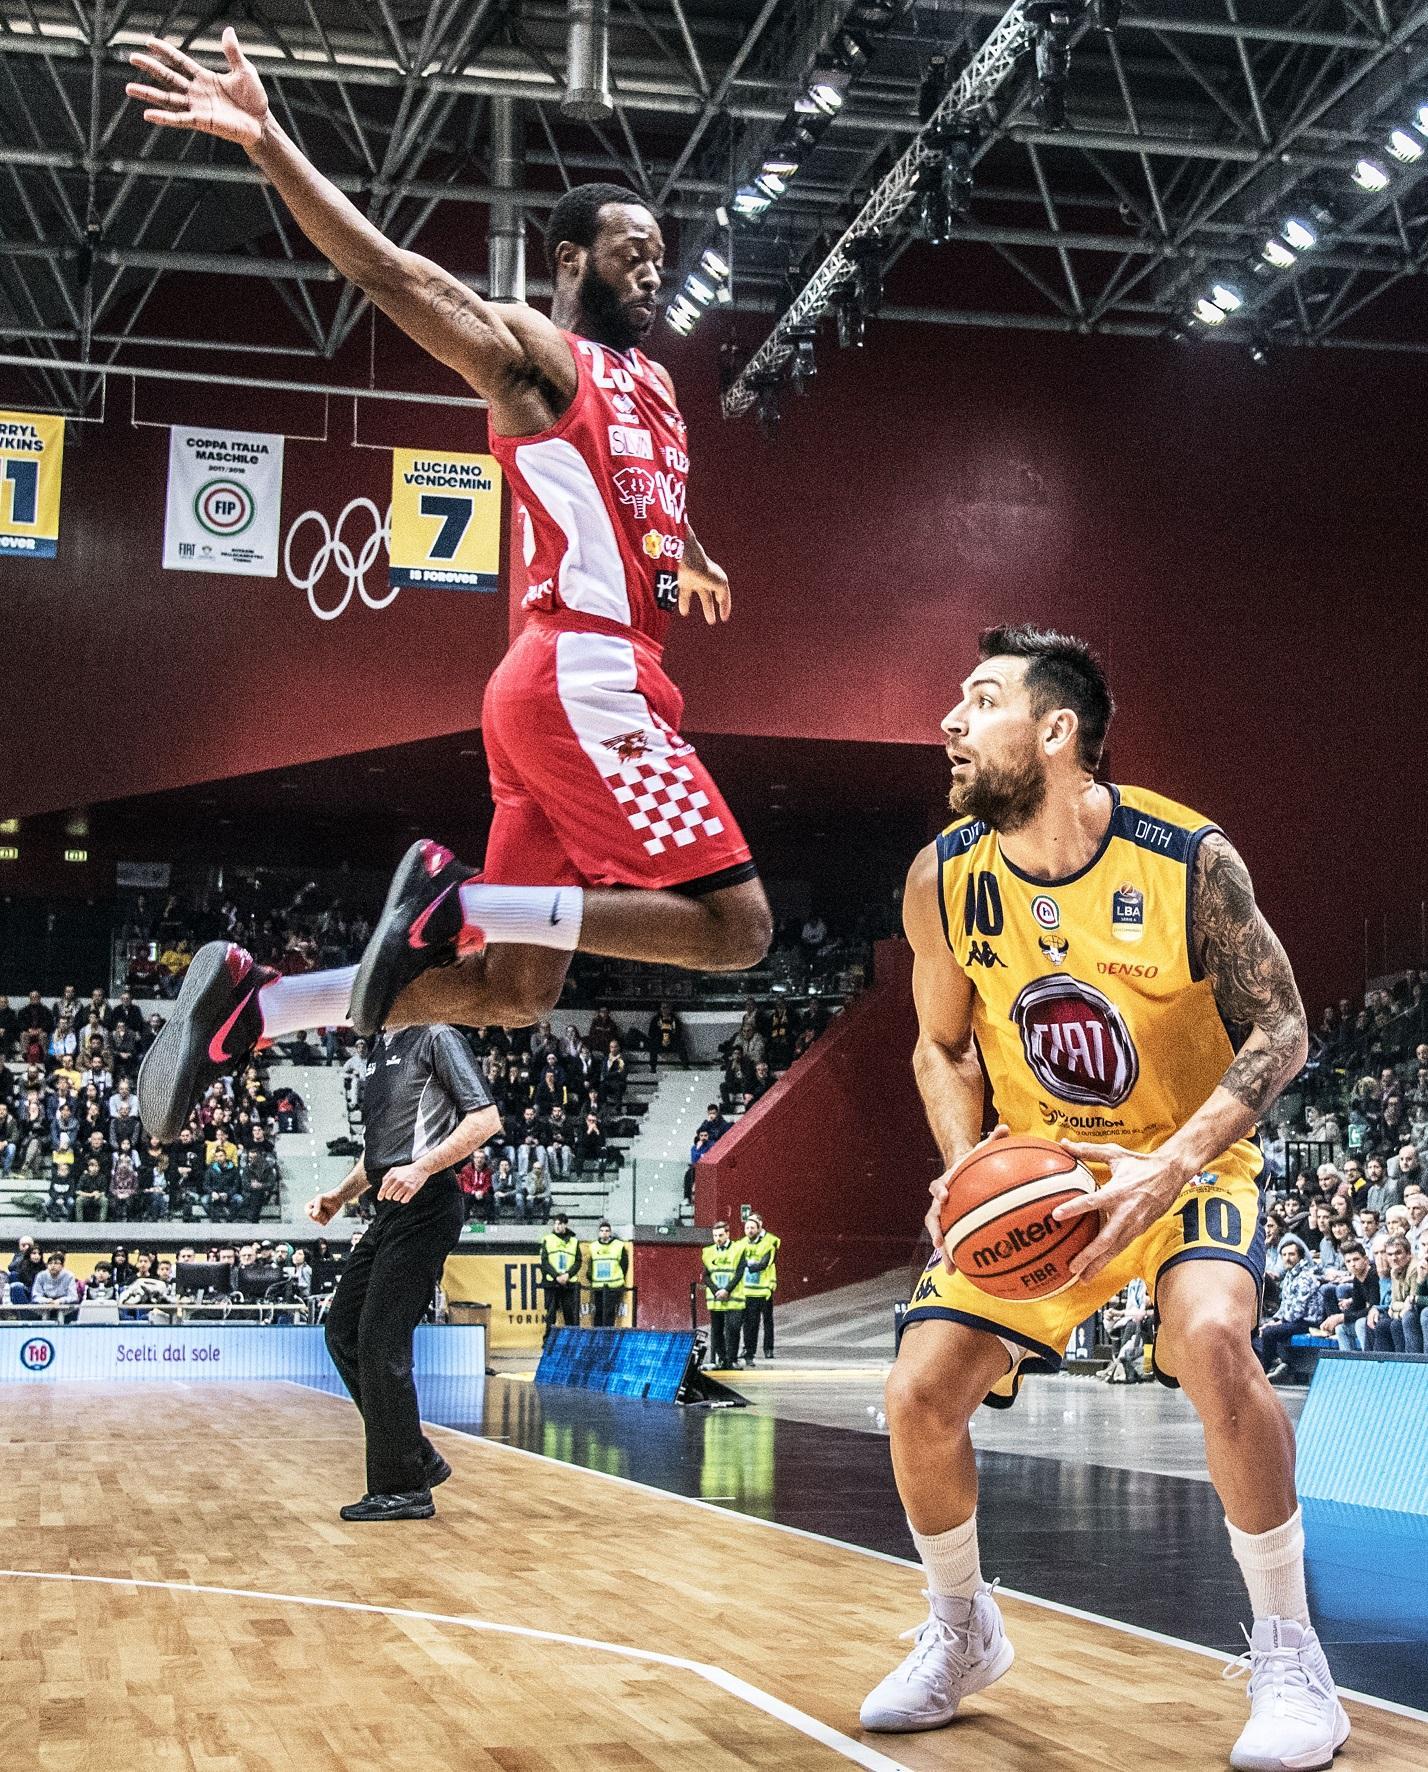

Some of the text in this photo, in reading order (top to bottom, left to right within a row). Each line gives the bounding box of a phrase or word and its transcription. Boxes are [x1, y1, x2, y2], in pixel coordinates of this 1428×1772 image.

[0, 439, 43, 451] KINS
[186, 438, 269, 454] COPPA ITALIA
[413, 461, 482, 477] LUCIANO
[215, 501, 236, 515] FIP
[420, 495, 473, 559] 7
[178, 542, 196, 556] FIAT
[1135, 819, 1173, 848] DITH
[964, 871, 1003, 936] 10
[1116, 906, 1140, 917] LBA
[1097, 962, 1159, 979] DENSO
[1031, 1021, 1105, 1081] FIAT
[1173, 1197, 1242, 1246] 10
[973, 1213, 1063, 1269] molten
[1020, 1262, 1057, 1287] FIBA
[117, 1345, 220, 1362] Scelti dal sole
